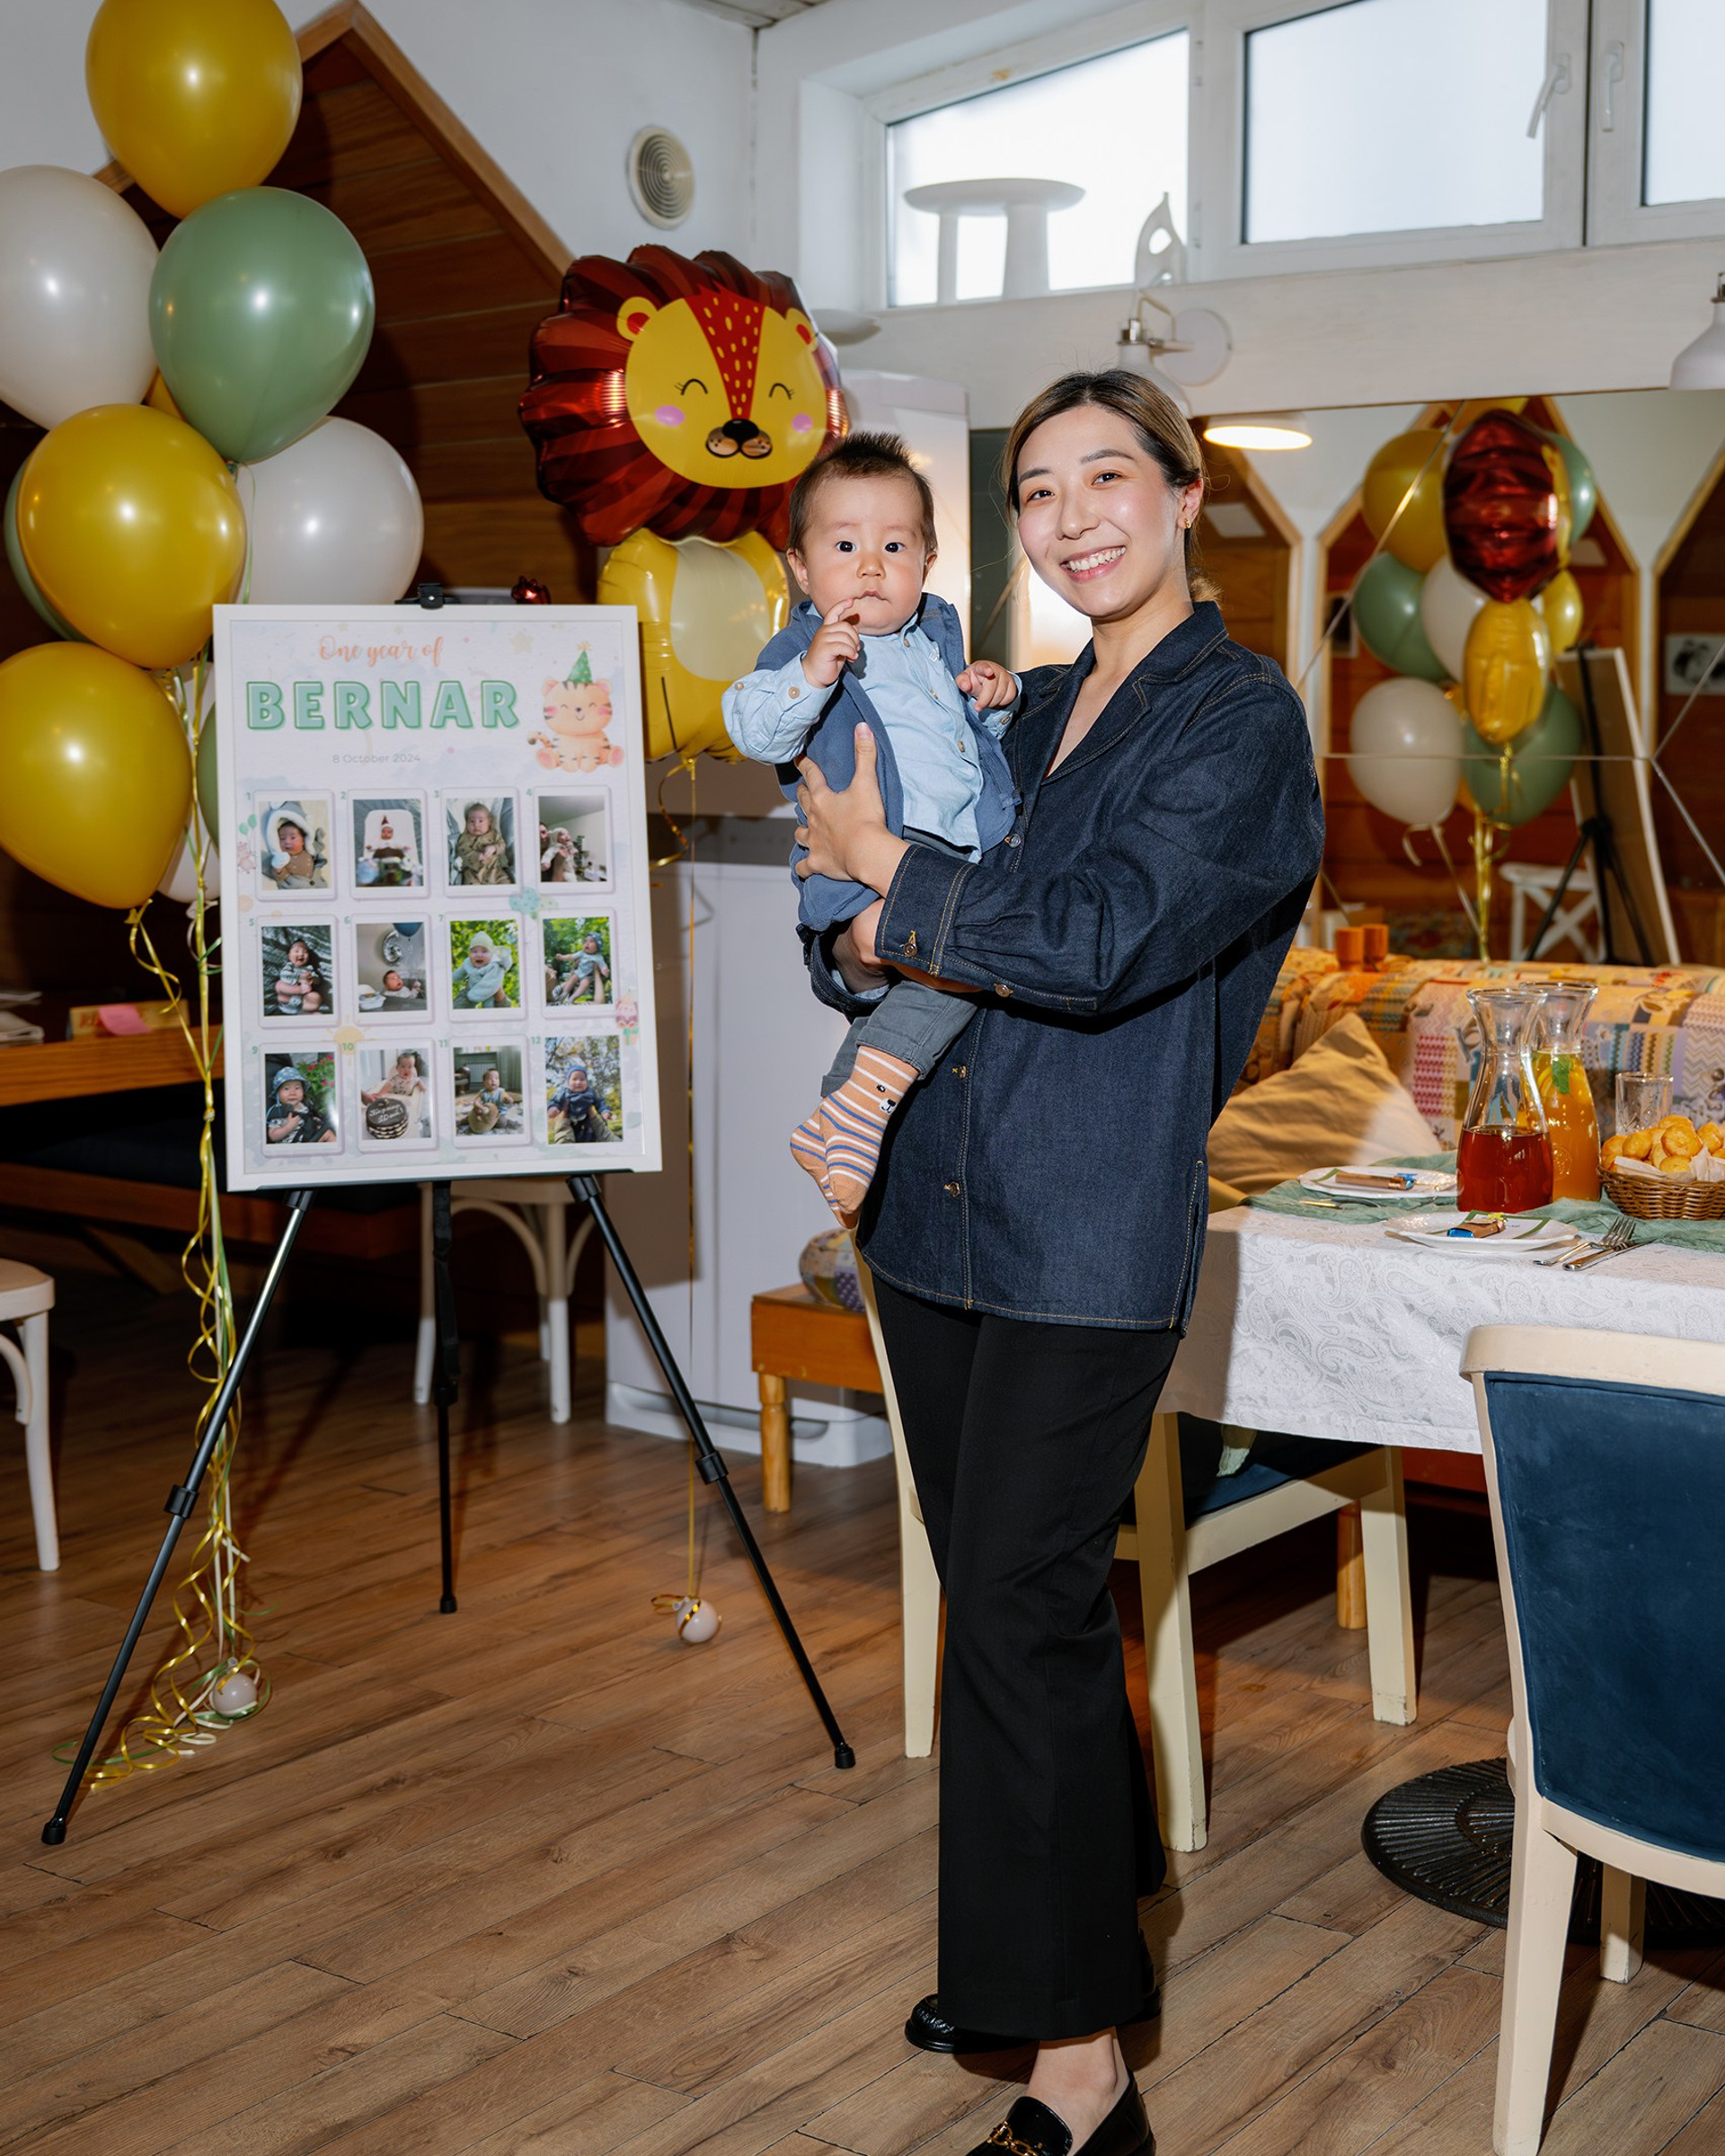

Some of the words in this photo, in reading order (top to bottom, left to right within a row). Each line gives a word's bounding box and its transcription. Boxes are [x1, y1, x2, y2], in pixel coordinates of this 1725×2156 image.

[319, 635, 359, 662] One
[367, 642, 416, 667] year
[422, 636, 444, 667] of
[246, 680, 520, 730] BERNAR
[332, 754, 341, 764] 8
[342, 754, 389, 764] October
[393, 753, 421, 764] 2024
[438, 1039, 447, 1047] 11
[531, 1036, 541, 1045] 12
[252, 1046, 258, 1055] 9
[342, 1042, 354, 1051] 10
